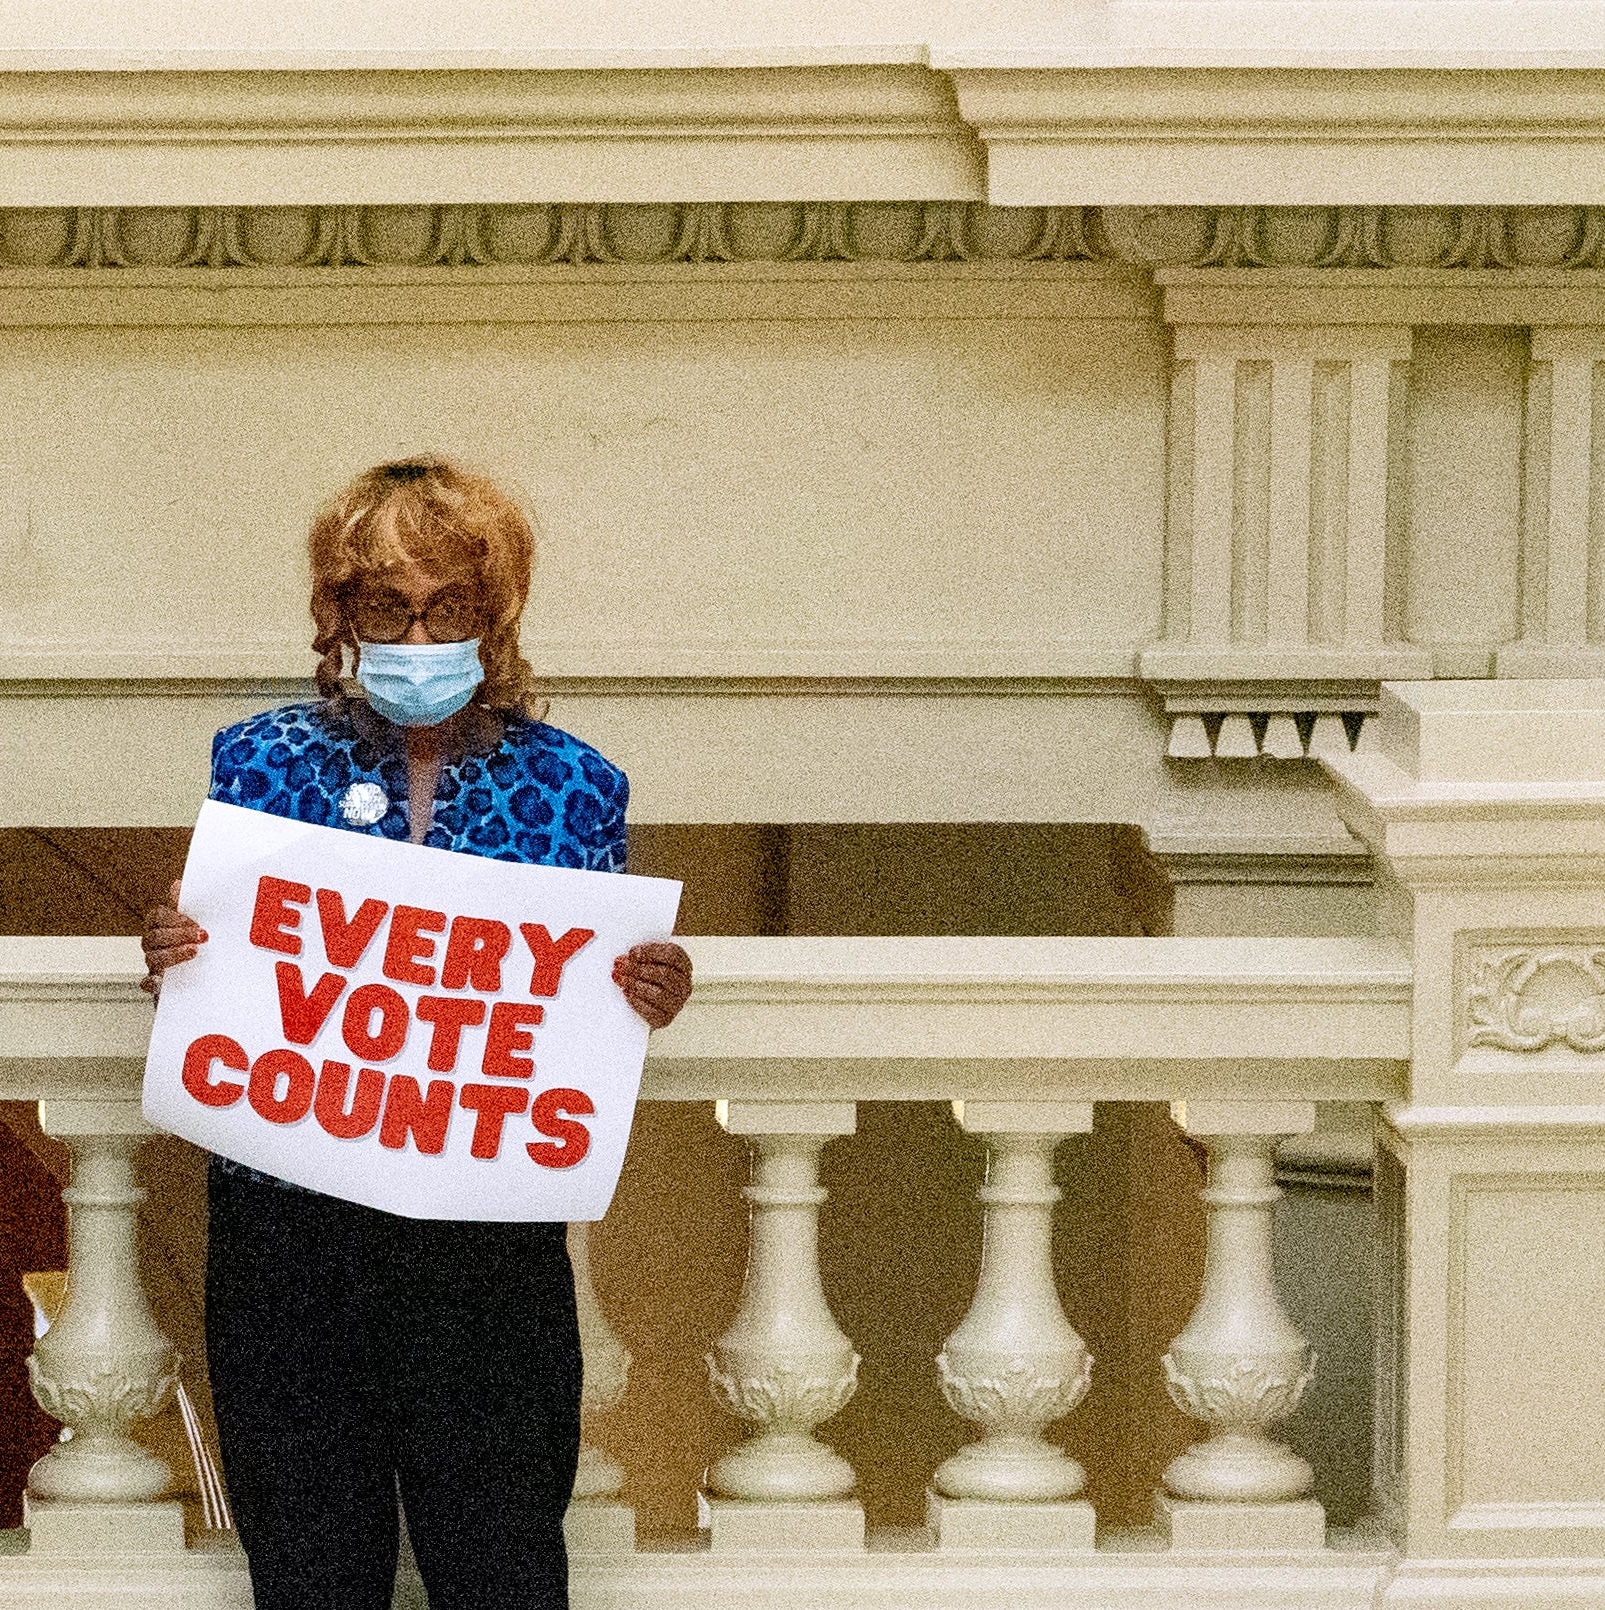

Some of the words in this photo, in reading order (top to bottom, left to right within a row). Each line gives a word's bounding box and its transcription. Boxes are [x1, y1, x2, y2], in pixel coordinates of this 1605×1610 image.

[248, 875, 595, 999] EVERY
[274, 961, 545, 1080] VOTE
[181, 1033, 596, 1170] COUNTS
